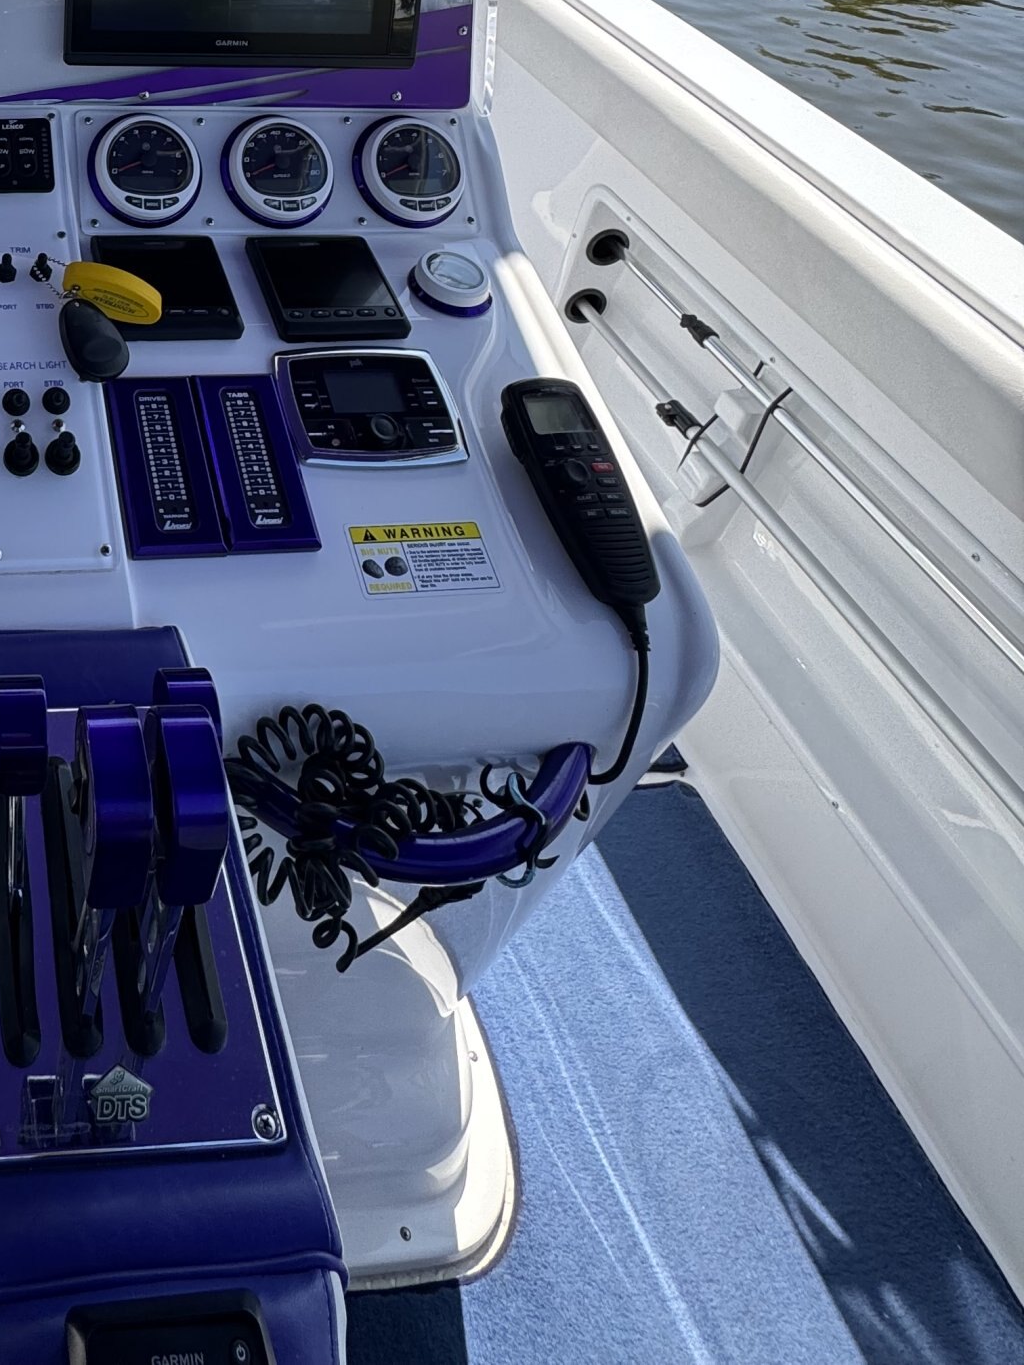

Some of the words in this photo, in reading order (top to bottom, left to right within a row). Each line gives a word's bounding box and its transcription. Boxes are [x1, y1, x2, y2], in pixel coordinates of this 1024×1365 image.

[39, 360, 68, 370] LIGHT
[383, 526, 465, 539] WARNING
[360, 547, 375, 556] BIG
[378, 547, 399, 555] NUTS
[368, 582, 412, 591] REQUIRED
[96, 1084, 143, 1094] SmartCraft
[97, 1094, 147, 1120] DTS
[151, 1352, 204, 1365] GARMIN
